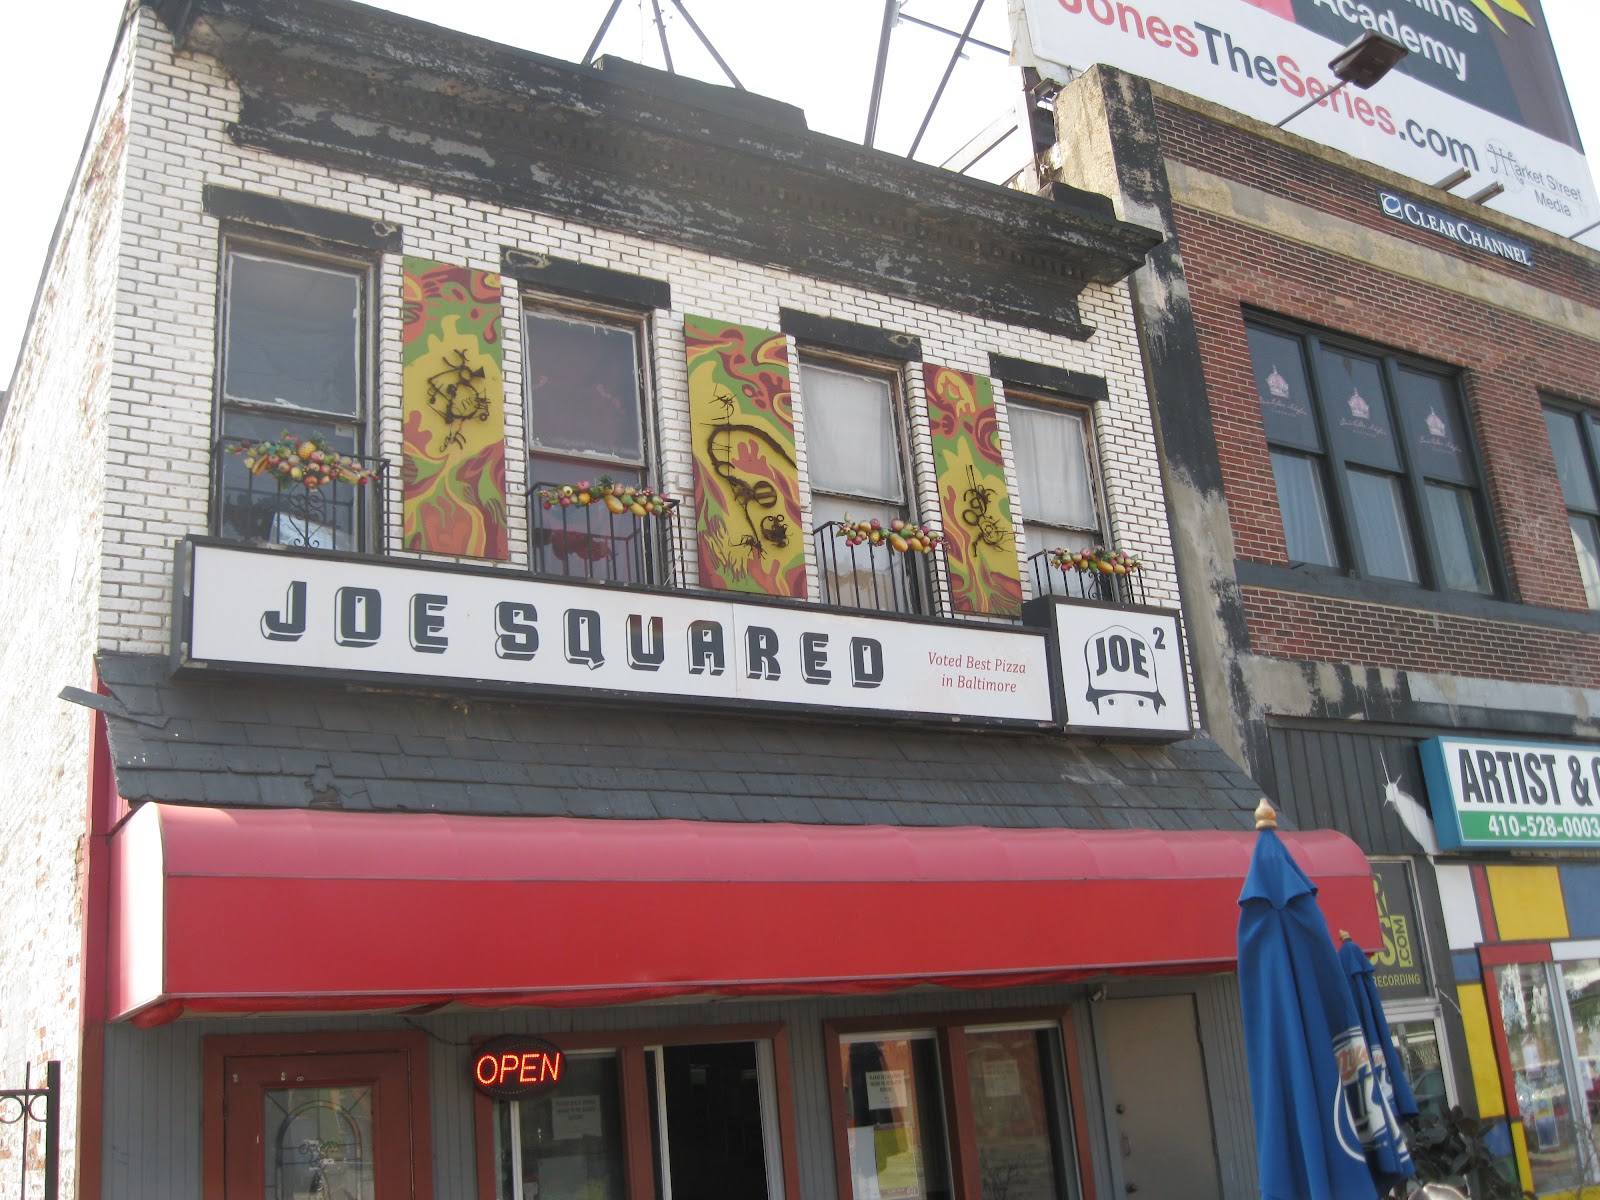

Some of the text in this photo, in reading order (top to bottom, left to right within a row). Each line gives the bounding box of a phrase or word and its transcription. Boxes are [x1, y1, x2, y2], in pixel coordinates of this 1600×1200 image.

[1058, 0, 1480, 172] onesTheSeries.com
[1534, 189, 1571, 216] Media
[1546, 174, 1583, 202] Street
[260, 580, 885, 688] JOE SQUARED
[928, 651, 1026, 674] Voted Best Pizza
[1095, 634, 1149, 679] JOE
[941, 674, 1017, 693] in Baltimore
[1458, 748, 1561, 806] ARTIST
[1567, 754, 1594, 807] &
[1488, 814, 1600, 838] 410-528-0003
[476, 1052, 561, 1085] OPEN
